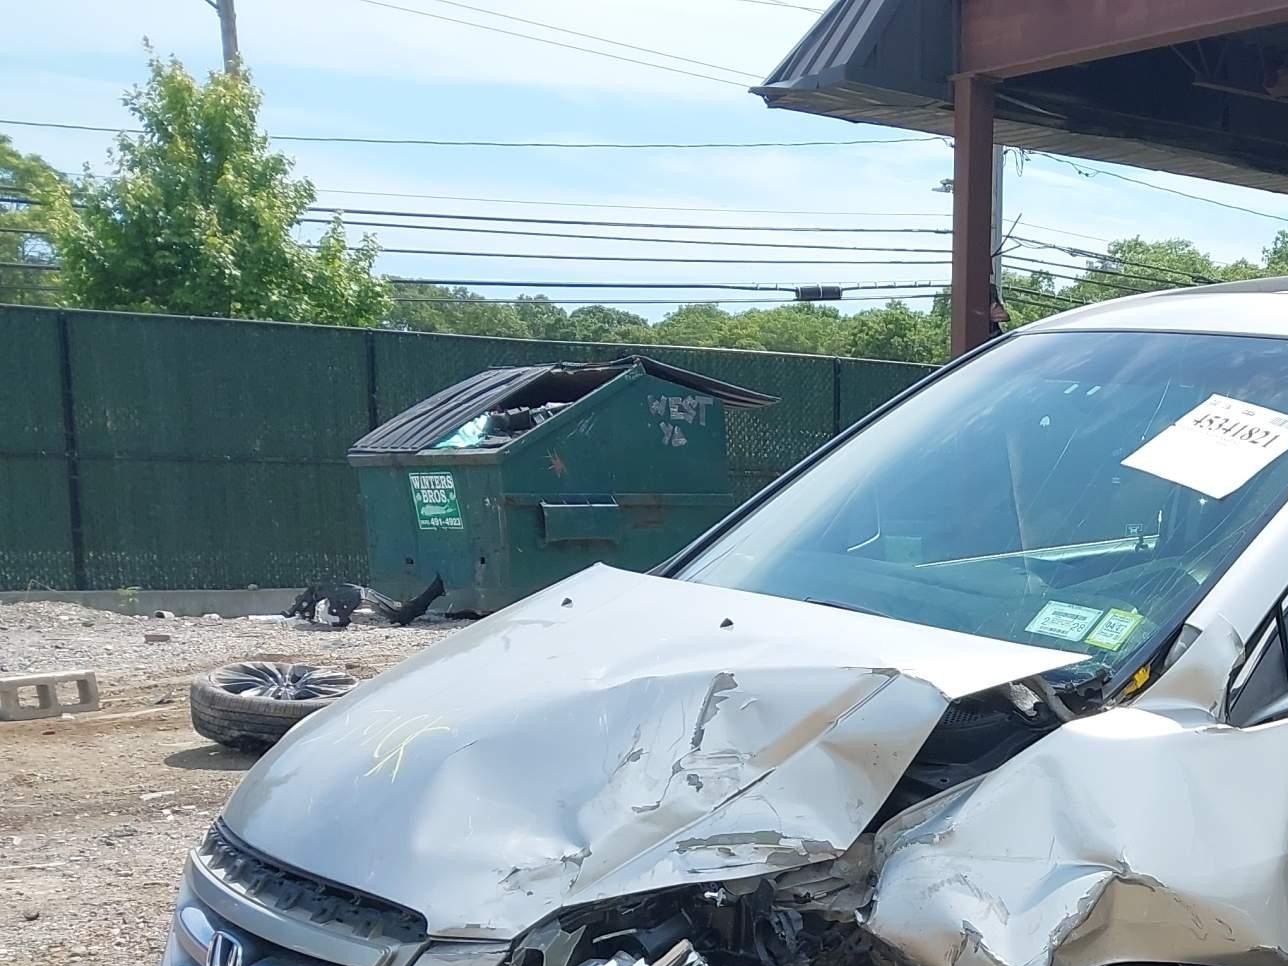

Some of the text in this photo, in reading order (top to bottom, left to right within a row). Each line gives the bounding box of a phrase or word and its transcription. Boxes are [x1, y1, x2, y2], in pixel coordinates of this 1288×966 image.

[648, 395, 713, 426] WEST
[1193, 413, 1281, 448] 45341821
[410, 475, 453, 489] WINTERS
[421, 490, 450, 503] BROS.
